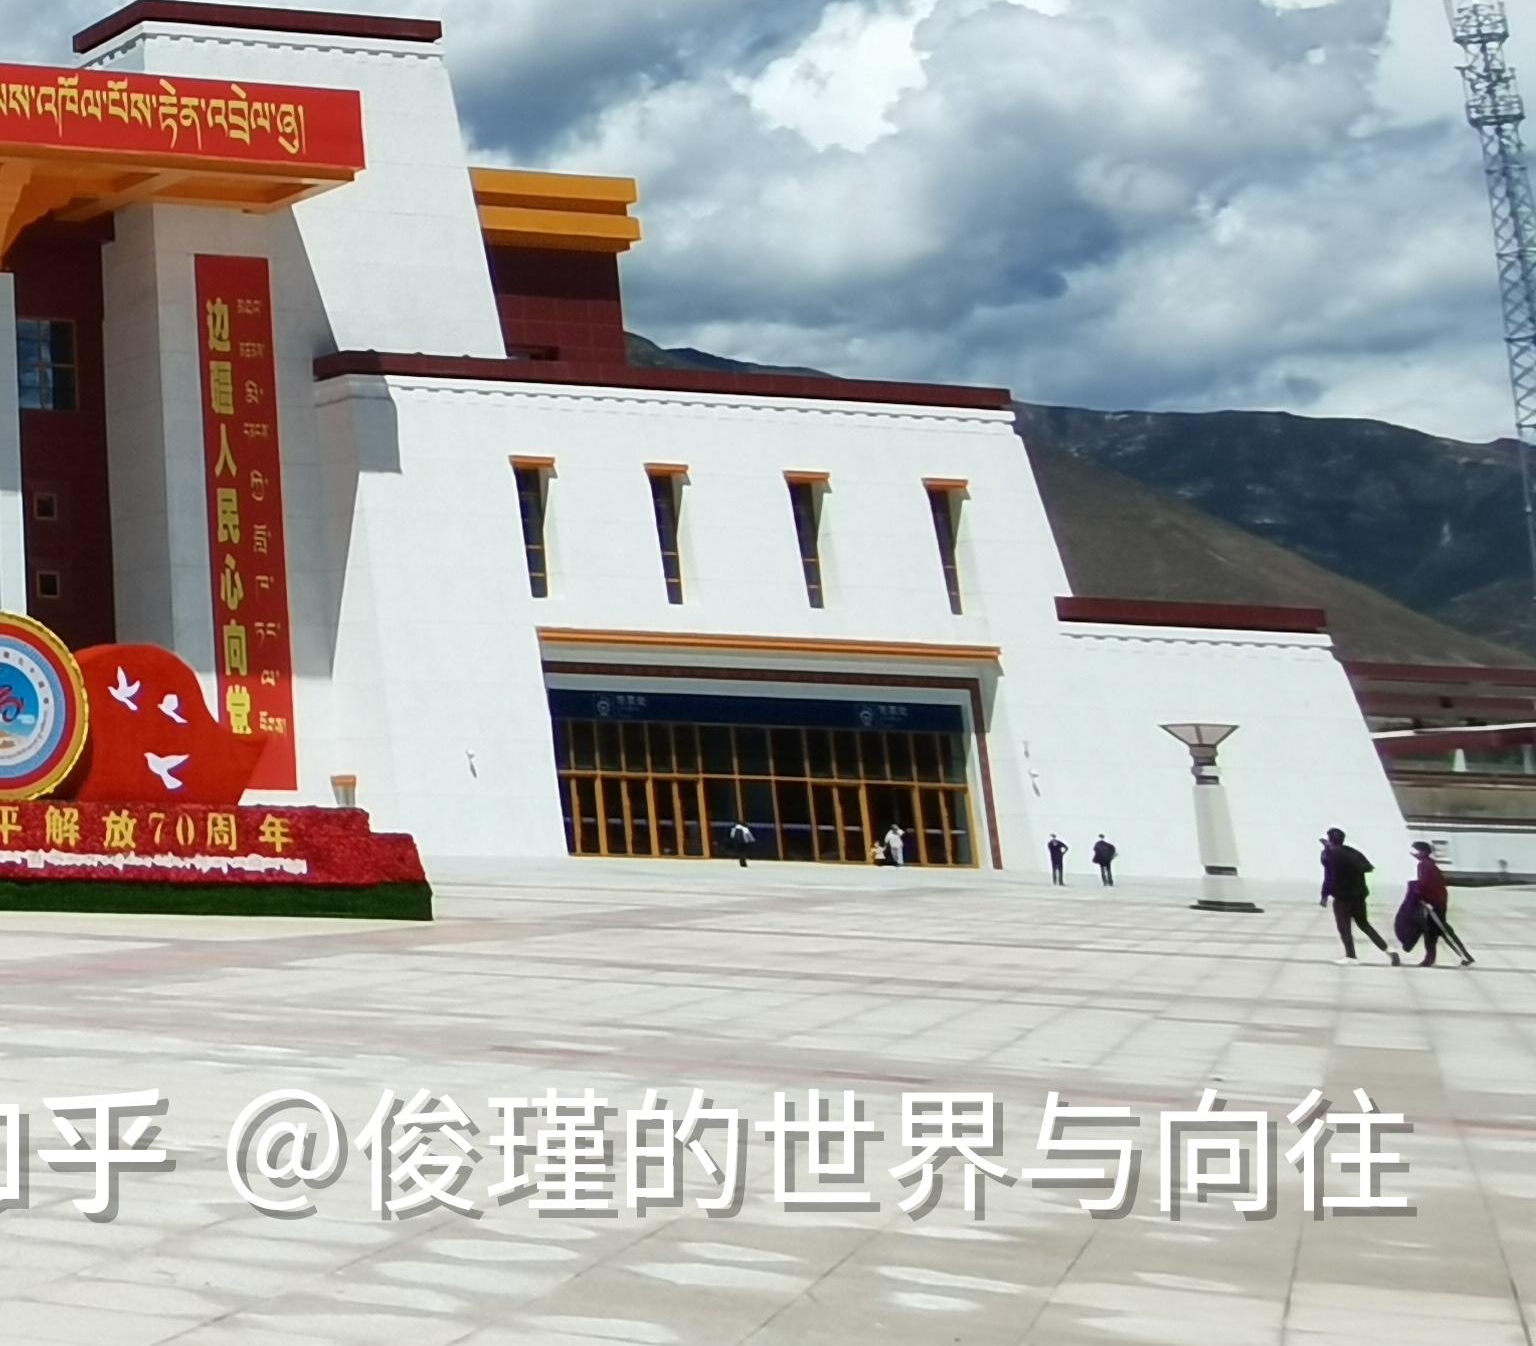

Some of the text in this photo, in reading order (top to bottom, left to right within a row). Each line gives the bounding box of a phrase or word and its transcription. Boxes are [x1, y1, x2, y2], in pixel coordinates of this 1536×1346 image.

[206, 296, 253, 736] 边疆人民心向党
